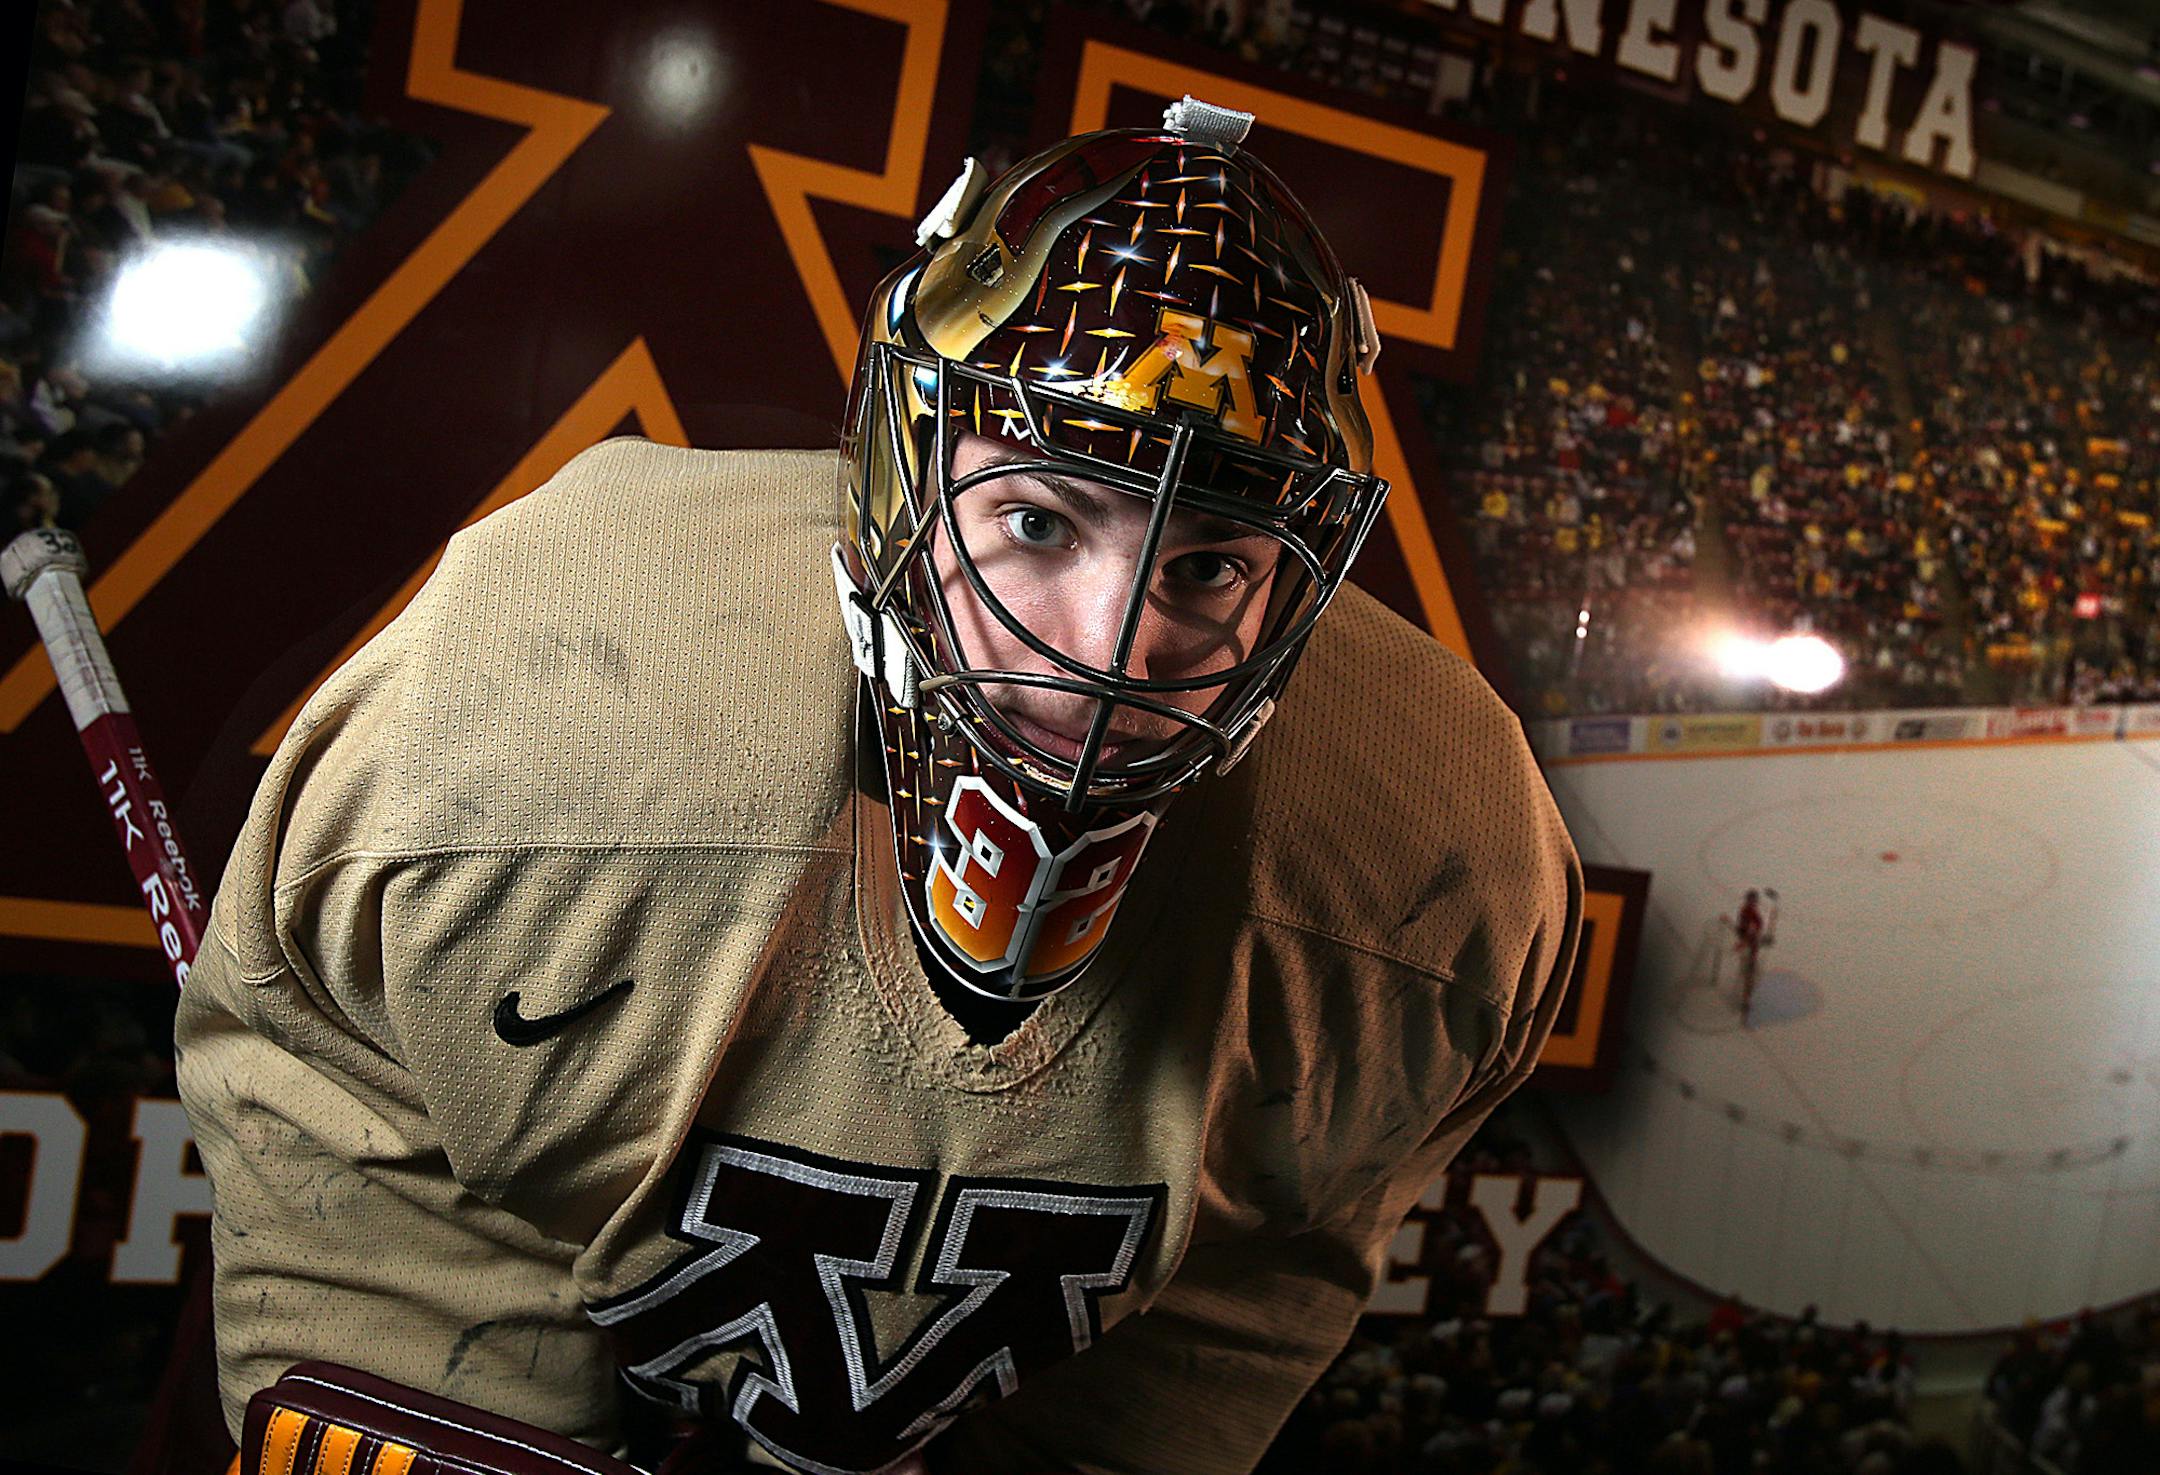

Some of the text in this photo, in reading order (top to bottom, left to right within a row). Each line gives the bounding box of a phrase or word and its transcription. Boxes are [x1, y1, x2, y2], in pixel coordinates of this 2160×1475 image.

[1420, 0, 1977, 180] ESOTA
[101, 758, 145, 852] 11K
[148, 799, 202, 912] Reebok
